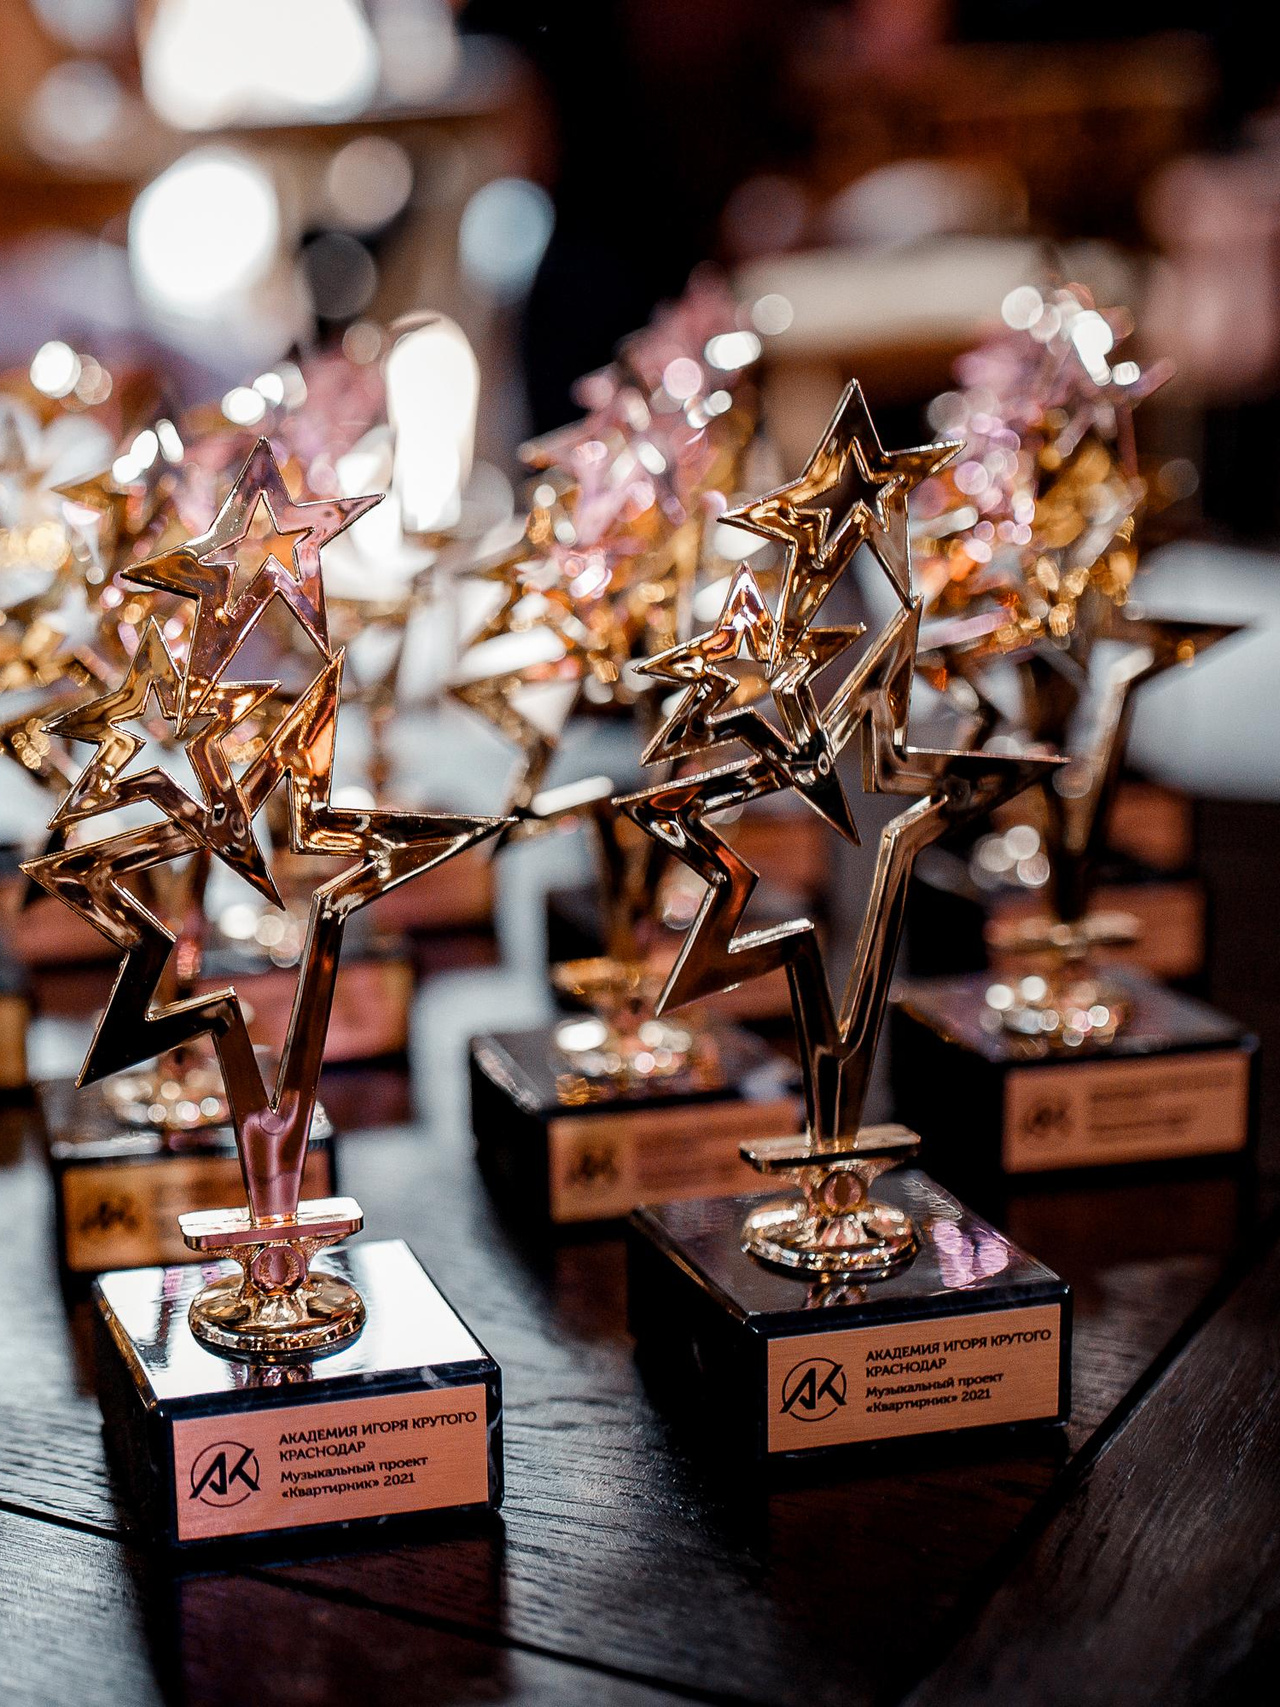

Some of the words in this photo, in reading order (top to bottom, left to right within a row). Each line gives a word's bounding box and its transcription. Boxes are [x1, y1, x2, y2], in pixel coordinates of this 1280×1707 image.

[865, 1343, 940, 1362] АКАДЕМИЯ
[943, 1337, 987, 1353] ИГОРЯ
[990, 1328, 1052, 1347] КРУТОГО
[866, 1358, 947, 1378] КРАСНОДАР
[865, 1376, 955, 1398] Музыкальный
[958, 1372, 1004, 1388] проект
[866, 1394, 958, 1415] «Квартирник»
[961, 1388, 991, 1403] 2021
[279, 1425, 358, 1446] АКАДЕМИЯ
[361, 1419, 408, 1436] ИГОРЯ
[412, 1411, 477, 1430] КРУТОГО
[280, 1441, 366, 1462] КРАСНОДАР
[280, 1461, 376, 1483] Музыкальный
[379, 1456, 428, 1474] проект
[281, 1479, 380, 1501] «Квартирник»
[383, 1472, 416, 1488] 2021
